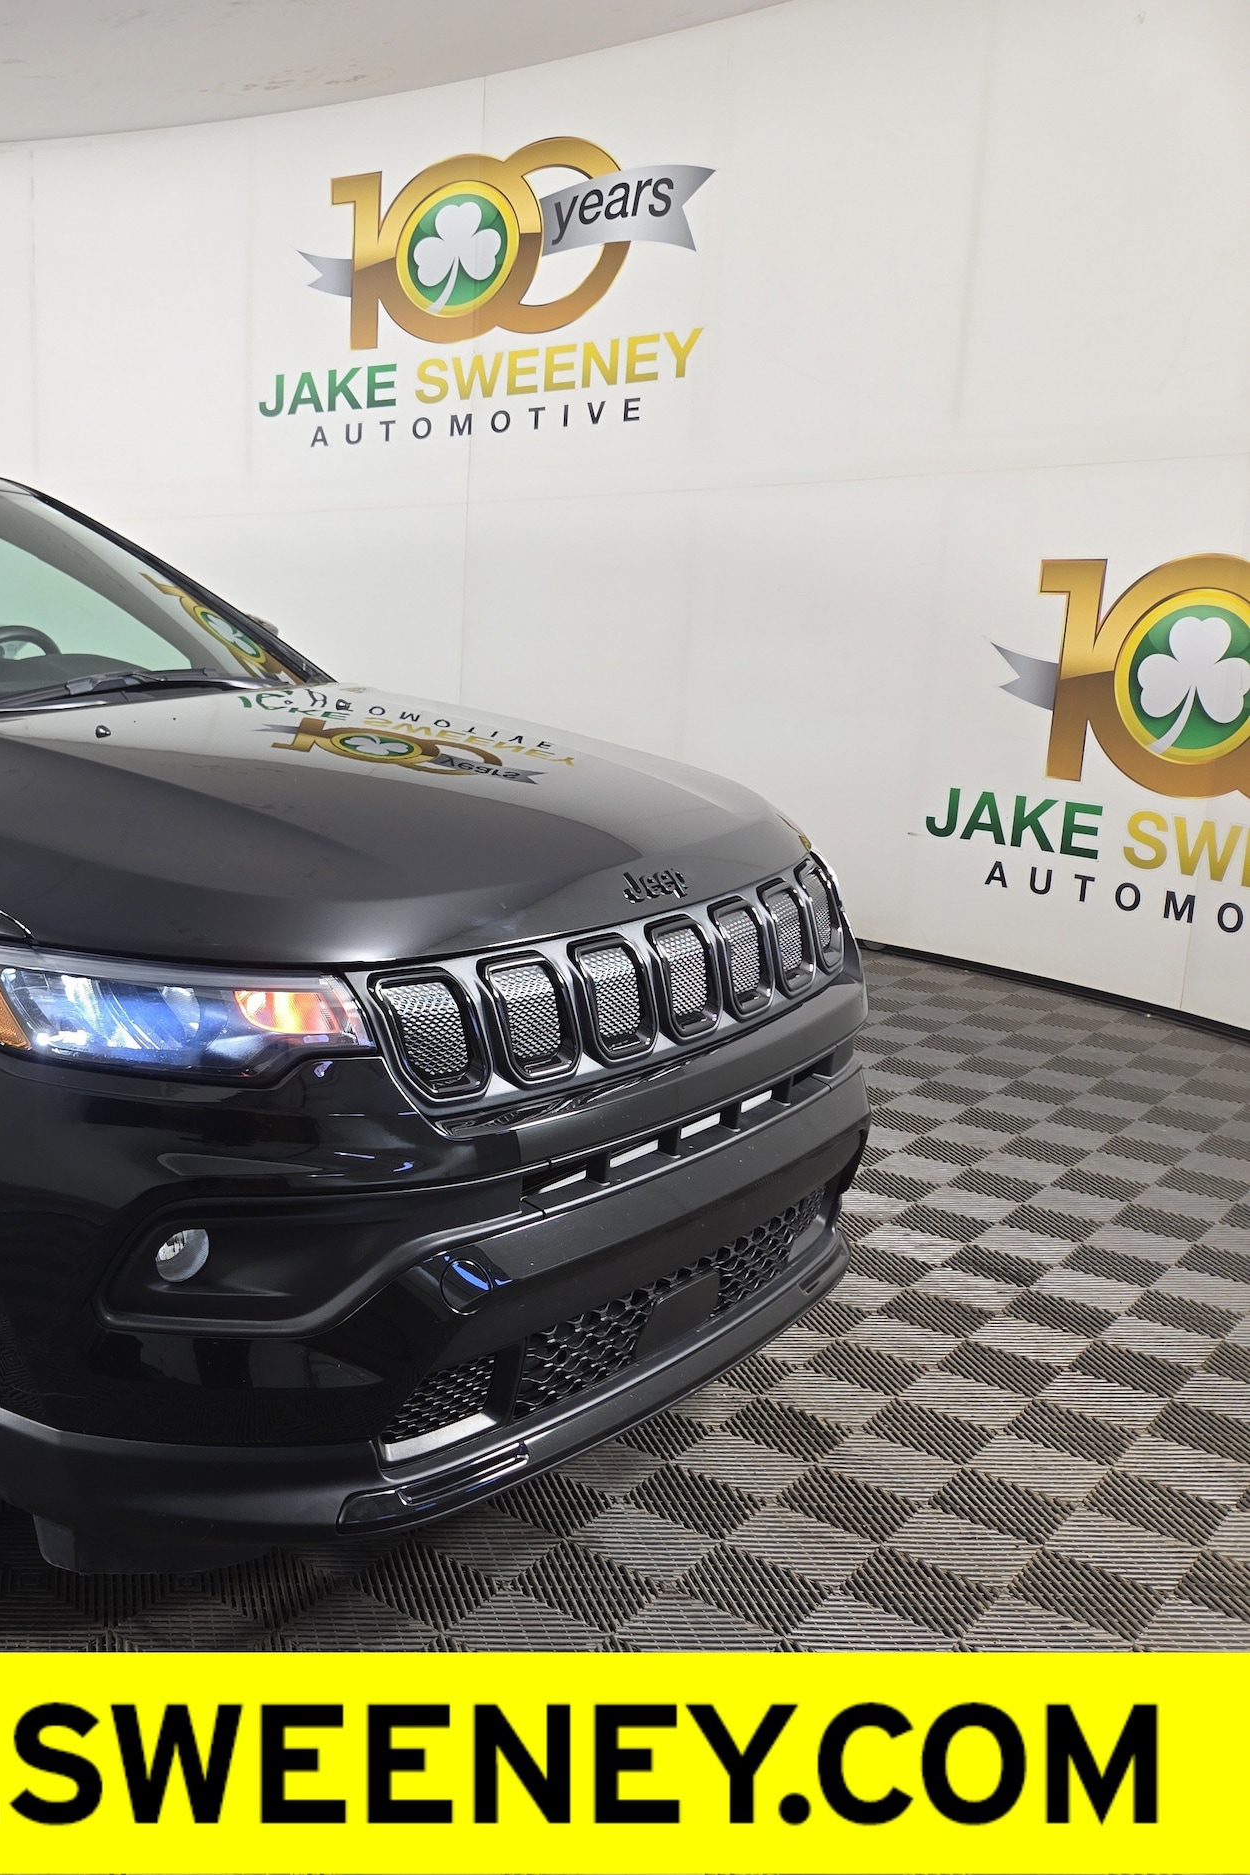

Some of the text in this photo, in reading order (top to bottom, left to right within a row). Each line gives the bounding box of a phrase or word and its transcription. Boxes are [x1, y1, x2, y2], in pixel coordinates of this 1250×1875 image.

[551, 176, 675, 246] years
[258, 328, 705, 418] JAKE SWEENEY
[310, 397, 642, 448] AUTOMOTIVE
[926, 787, 1250, 888] JAKE SW
[622, 867, 689, 904] Jeep
